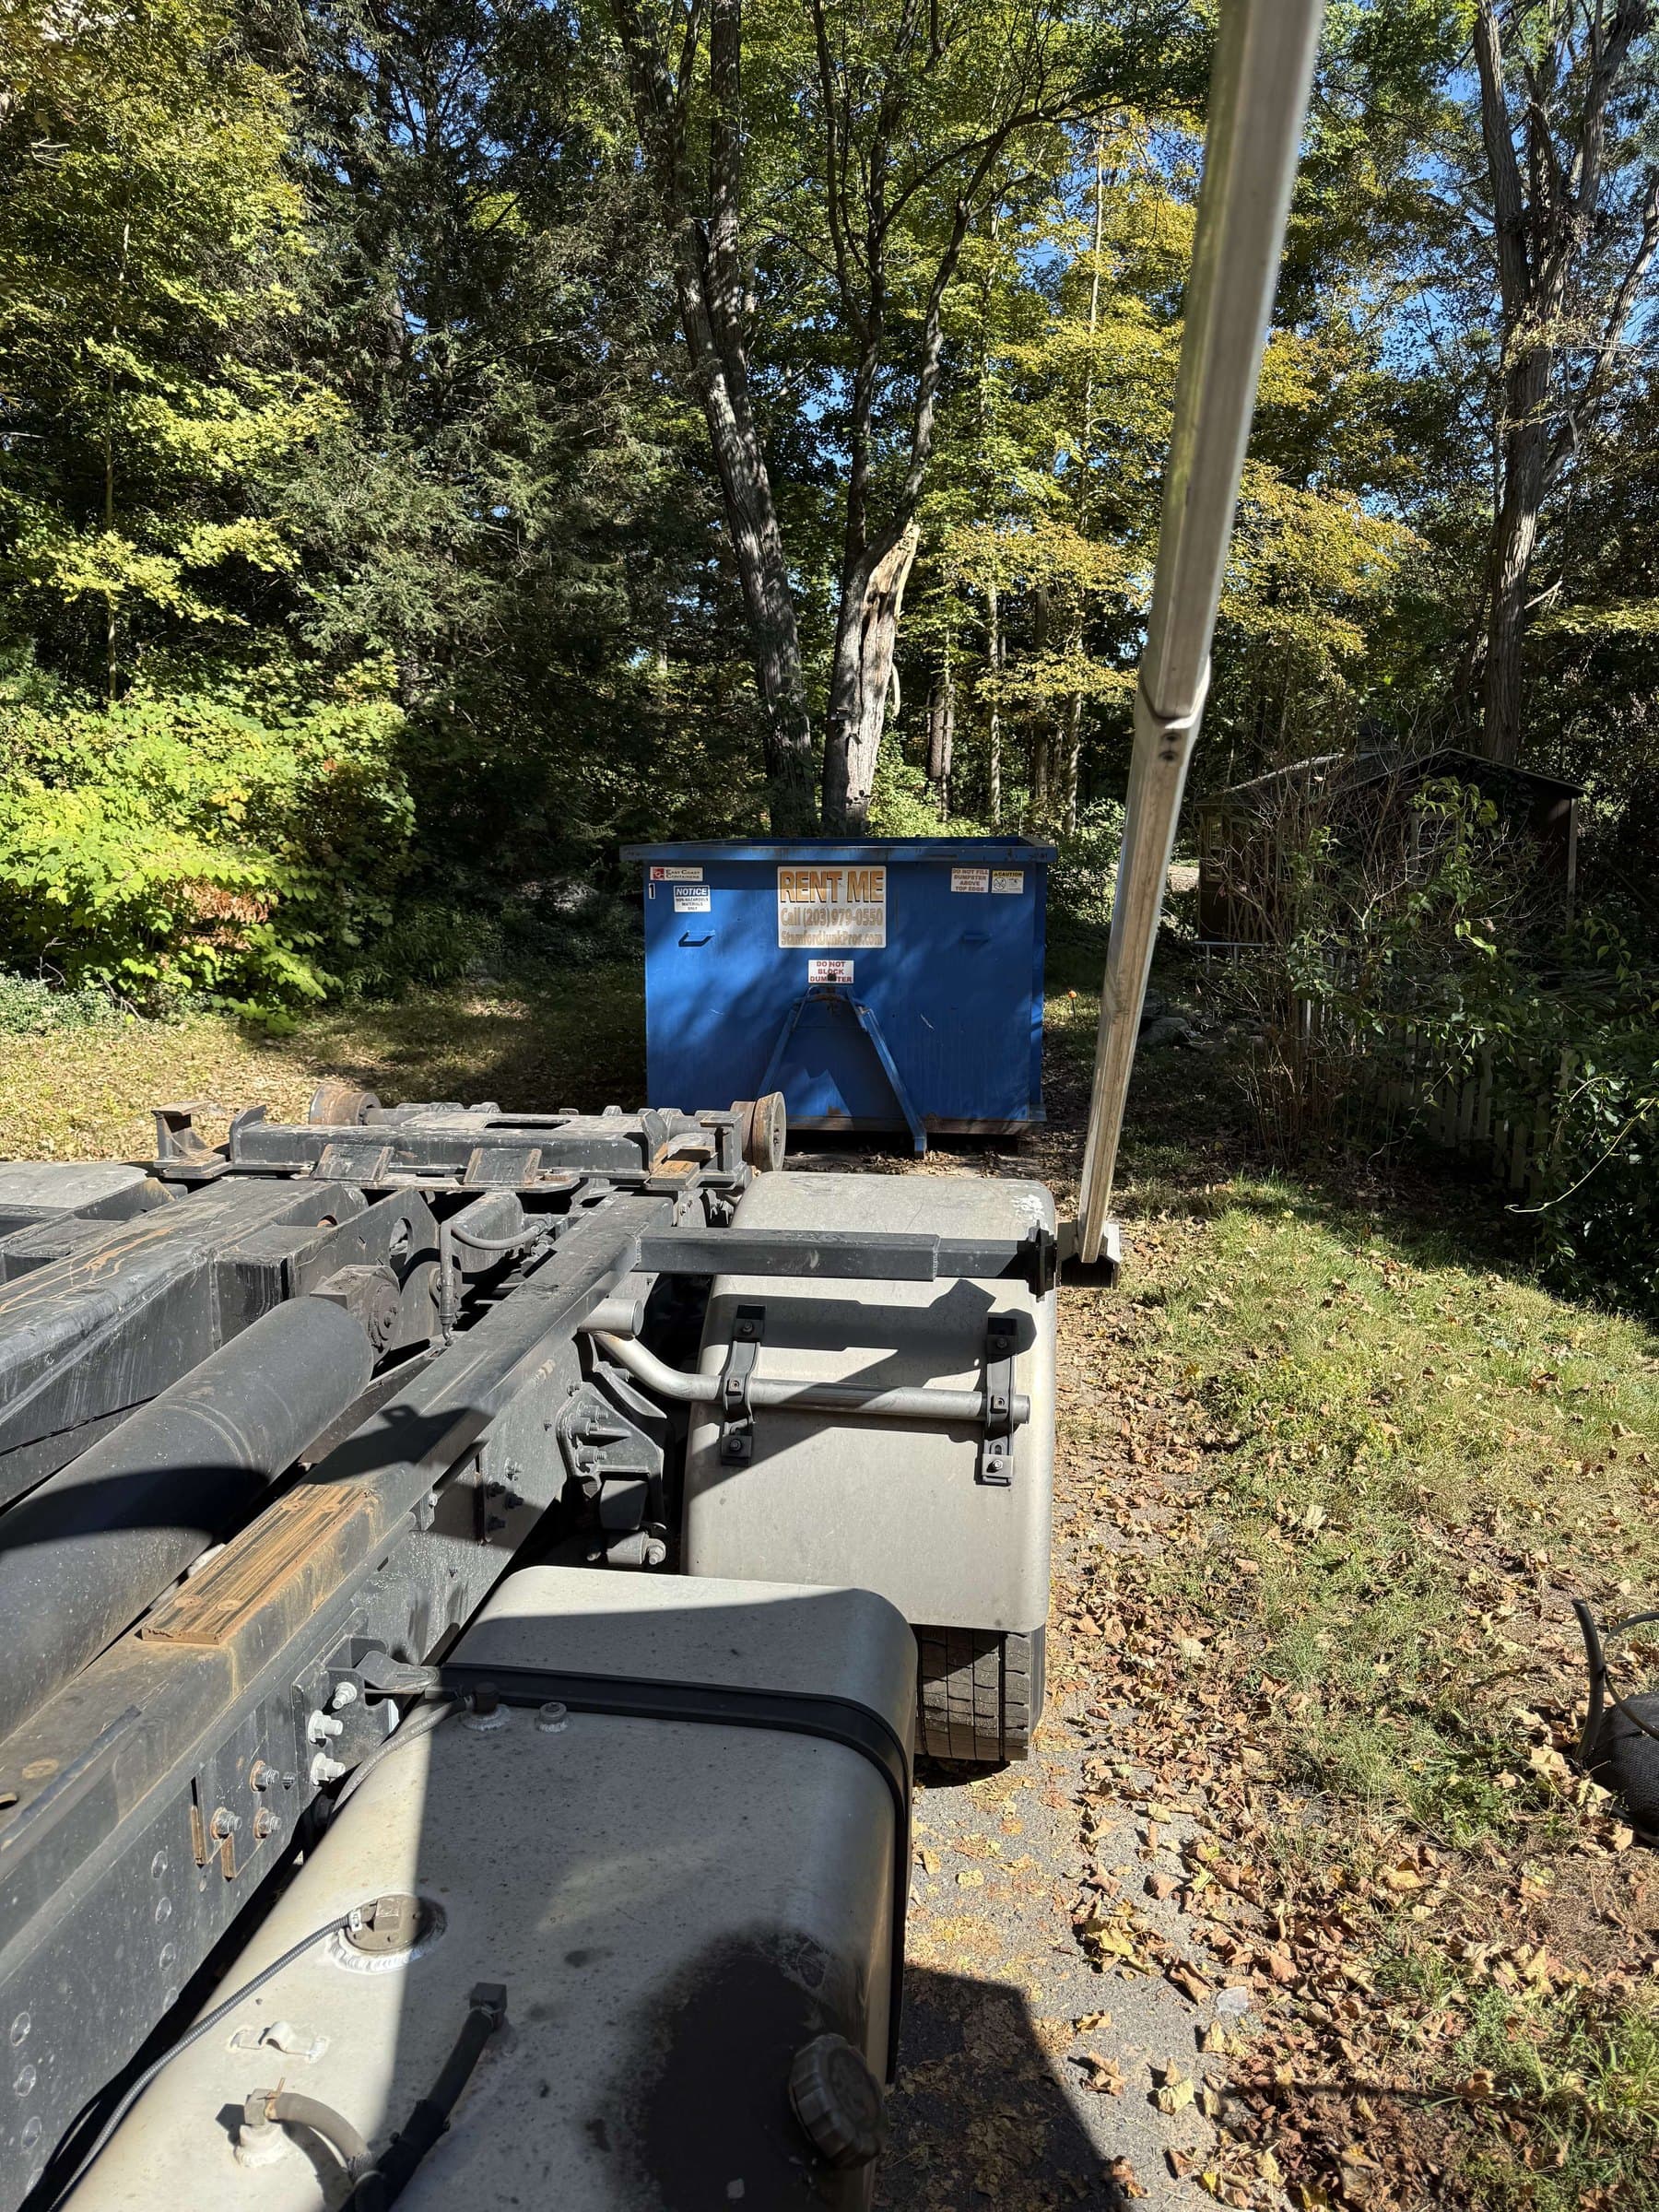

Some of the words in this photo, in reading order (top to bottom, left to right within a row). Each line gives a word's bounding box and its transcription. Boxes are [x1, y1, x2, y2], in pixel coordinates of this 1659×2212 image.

[676, 888, 708, 896] NOTICE
[780, 871, 842, 902] RENT
[847, 871, 884, 902] ME
[781, 907, 801, 925] Call
